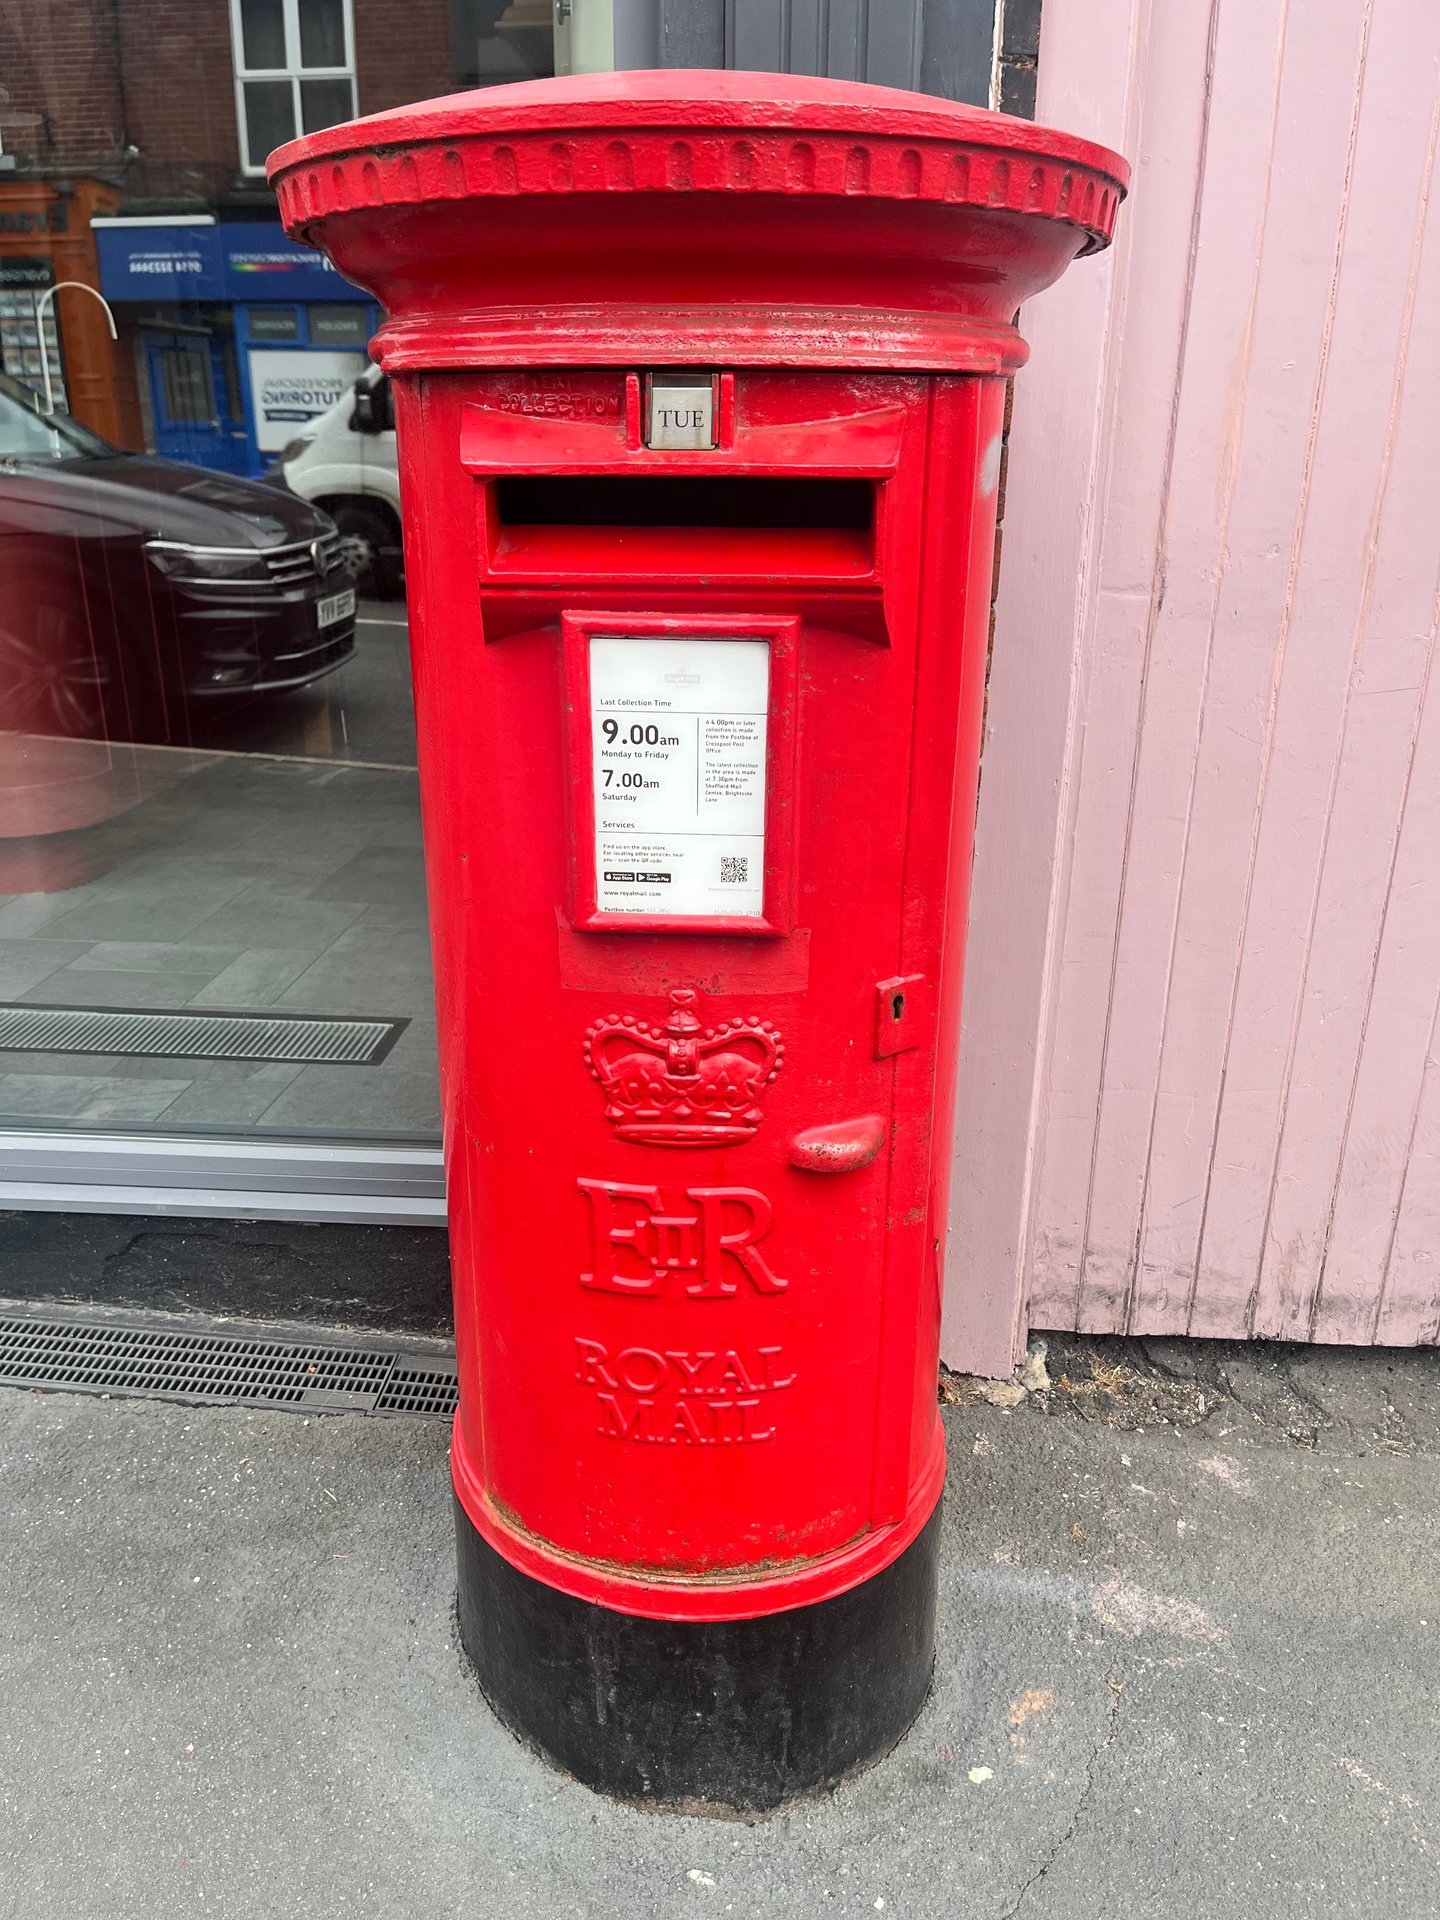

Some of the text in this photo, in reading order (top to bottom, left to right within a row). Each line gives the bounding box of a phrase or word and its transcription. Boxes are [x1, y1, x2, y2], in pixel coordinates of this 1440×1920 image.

[658, 410, 704, 428] TUE
[602, 718, 680, 746] 9.00am
[601, 750, 632, 759] Monday
[645, 751, 669, 760] Friday
[602, 769, 660, 788] 7.00am
[602, 793, 637, 802] Saturday
[603, 821, 635, 829] Services
[574, 1336, 797, 1394] ROYAL
[597, 1392, 776, 1445] MAIL
